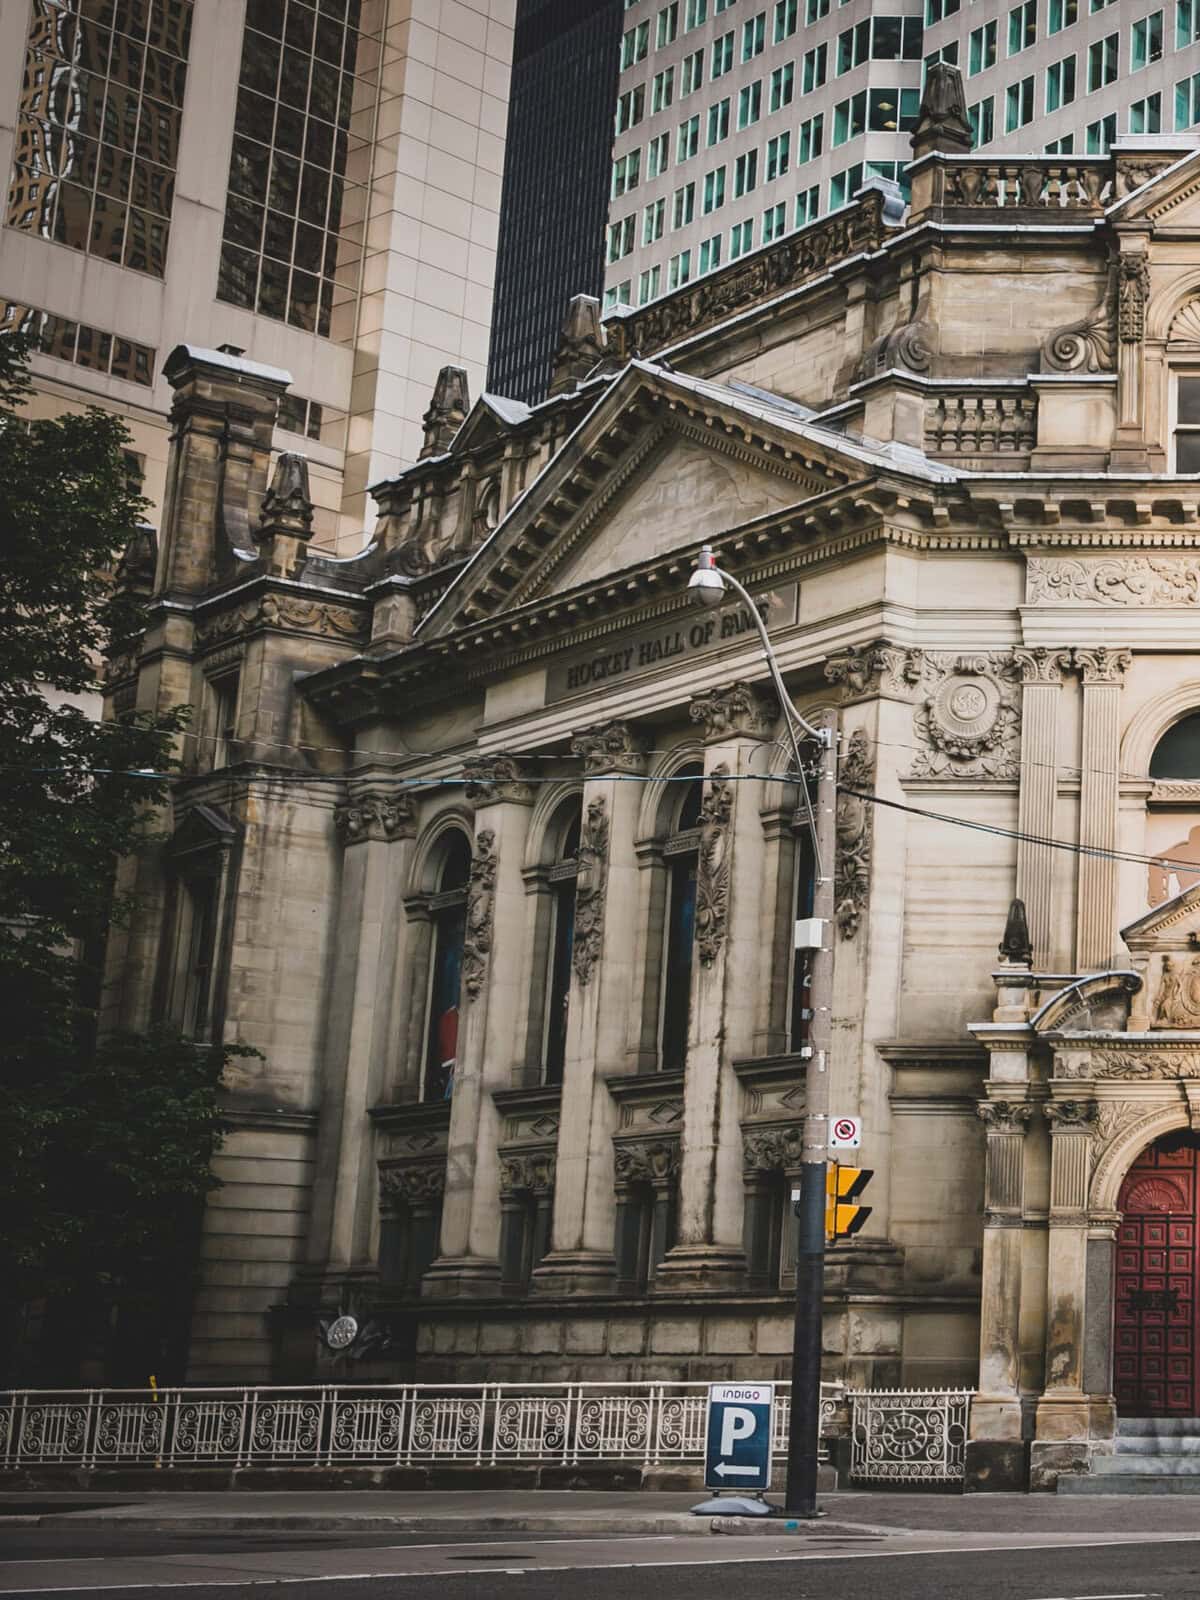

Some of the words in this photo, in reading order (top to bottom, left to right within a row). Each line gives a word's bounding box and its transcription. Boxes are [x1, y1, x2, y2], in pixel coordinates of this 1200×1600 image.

[567, 649, 633, 690] HOCKEY
[639, 632, 684, 666] HALL
[690, 621, 715, 648] OF
[720, 1407, 757, 1456] P
